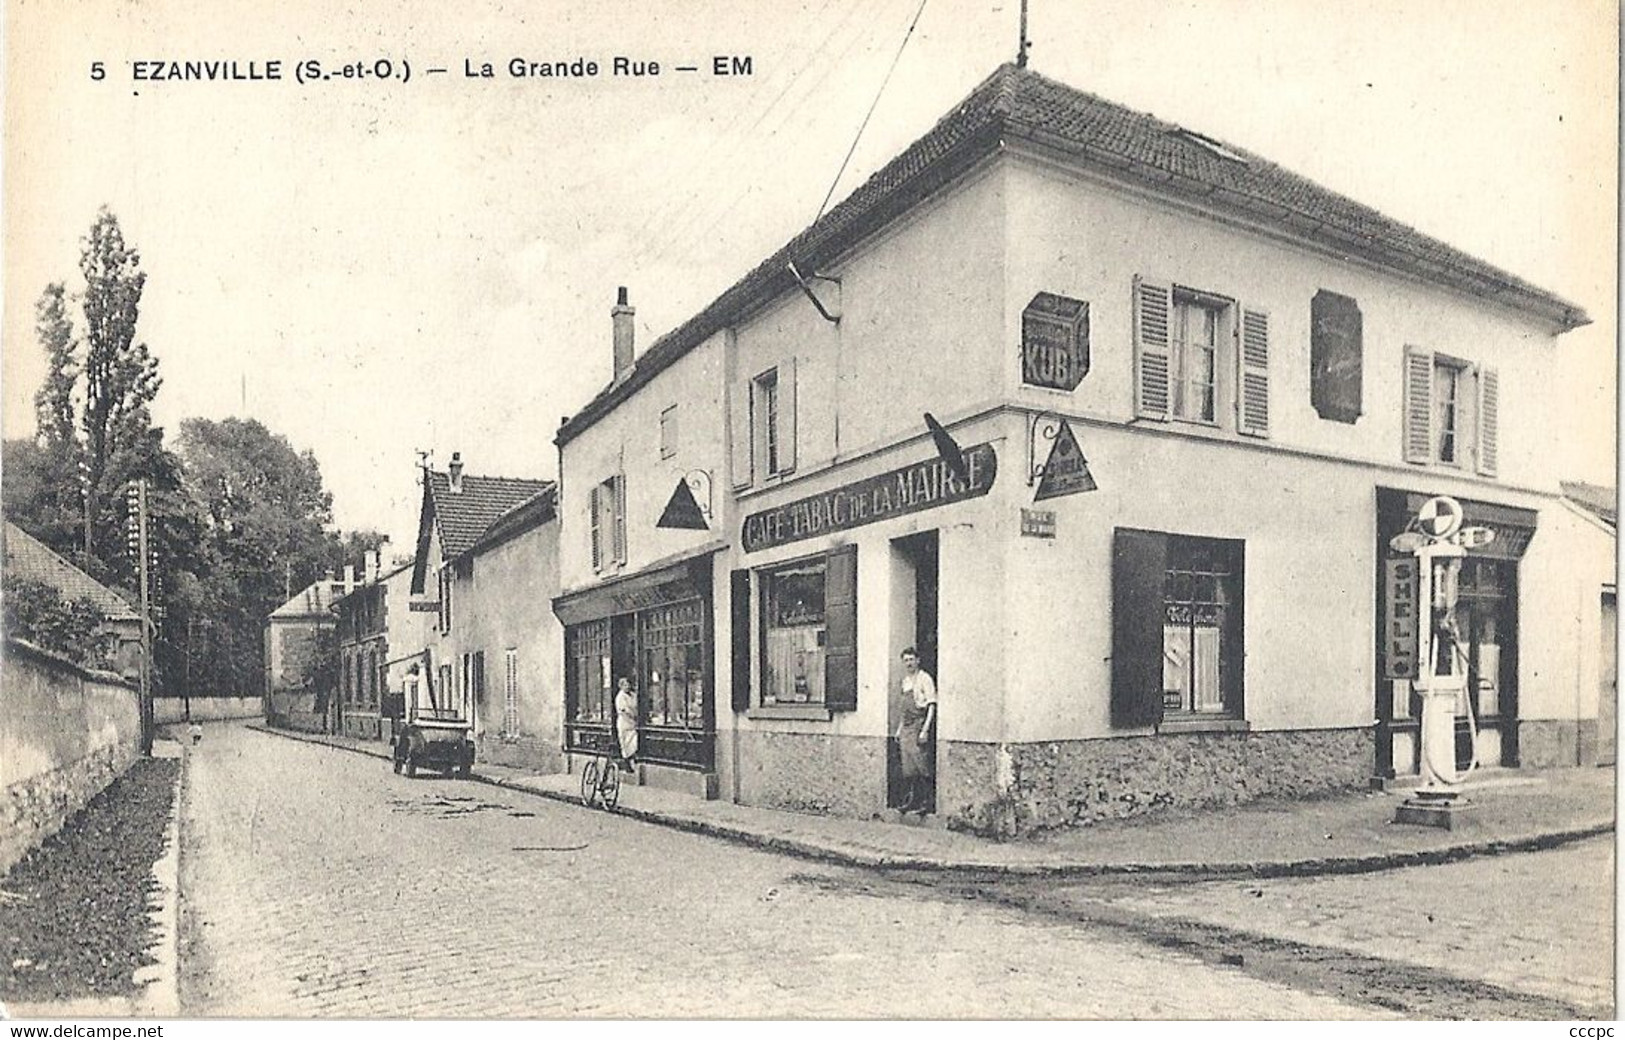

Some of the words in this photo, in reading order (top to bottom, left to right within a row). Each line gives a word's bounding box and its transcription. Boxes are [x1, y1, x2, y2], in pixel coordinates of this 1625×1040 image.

[1025, 342, 1068, 385] KUB
[850, 493, 868, 521] DE
[873, 486, 892, 515] LA
[896, 450, 983, 509] MAIRE
[1393, 563, 1412, 658] SHELL
